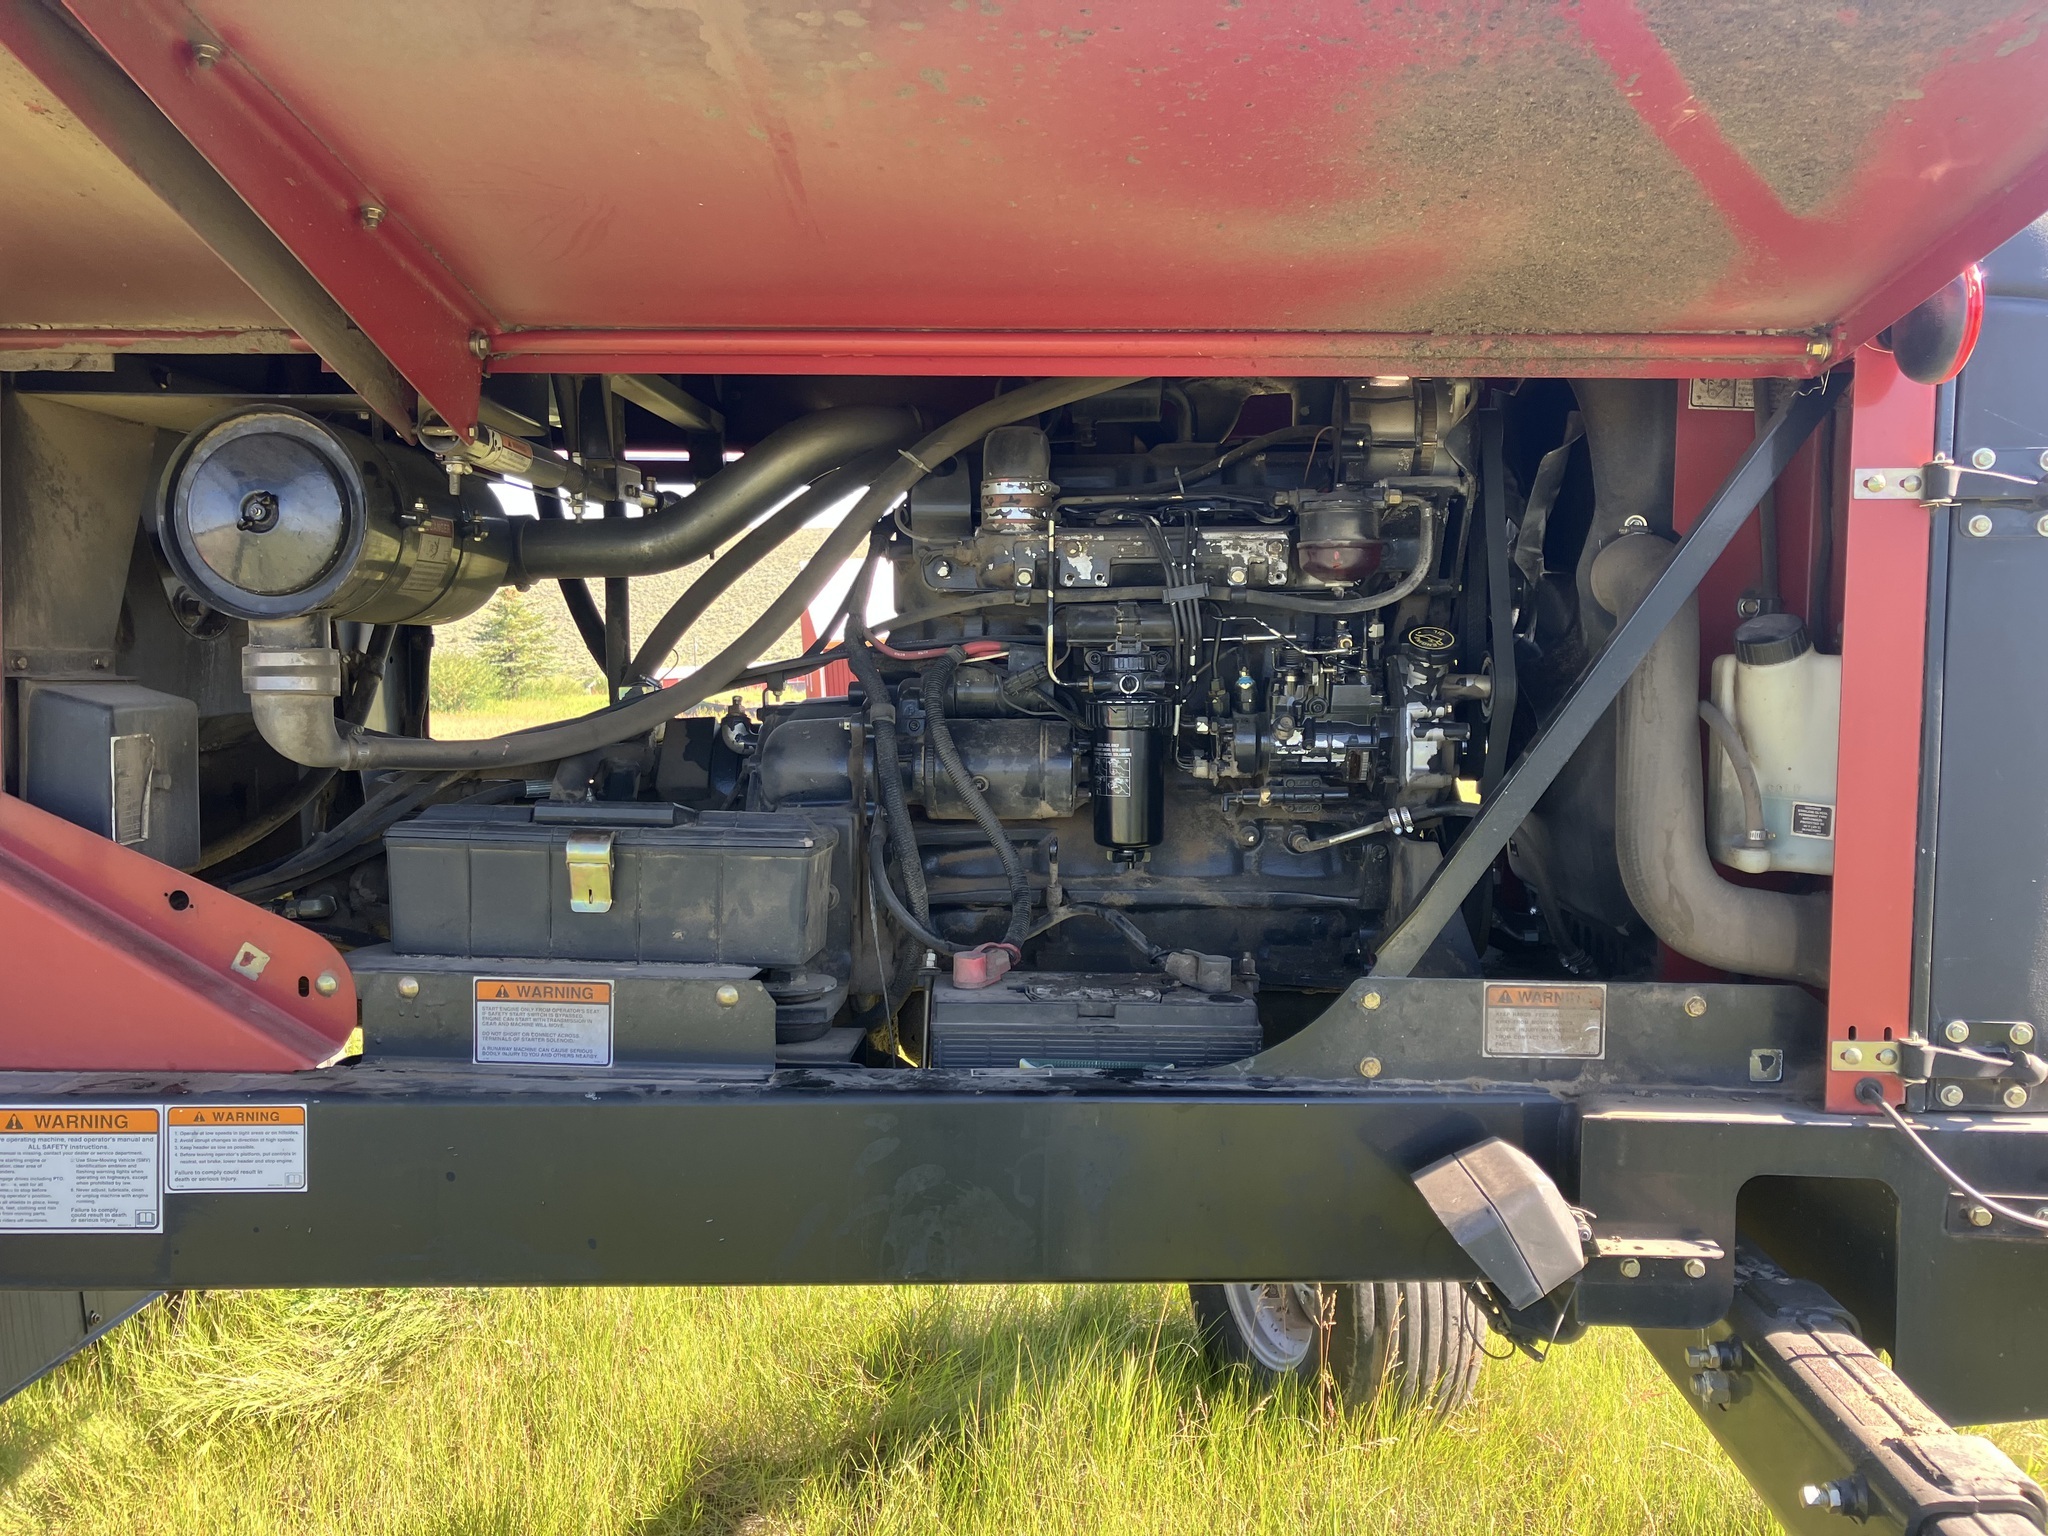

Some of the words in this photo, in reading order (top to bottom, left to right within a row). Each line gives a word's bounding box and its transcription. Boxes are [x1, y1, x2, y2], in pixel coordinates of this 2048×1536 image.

[516, 985, 594, 1000] WARNING
[34, 1114, 129, 1129] WARNING
[212, 1111, 280, 1122] WARNING
